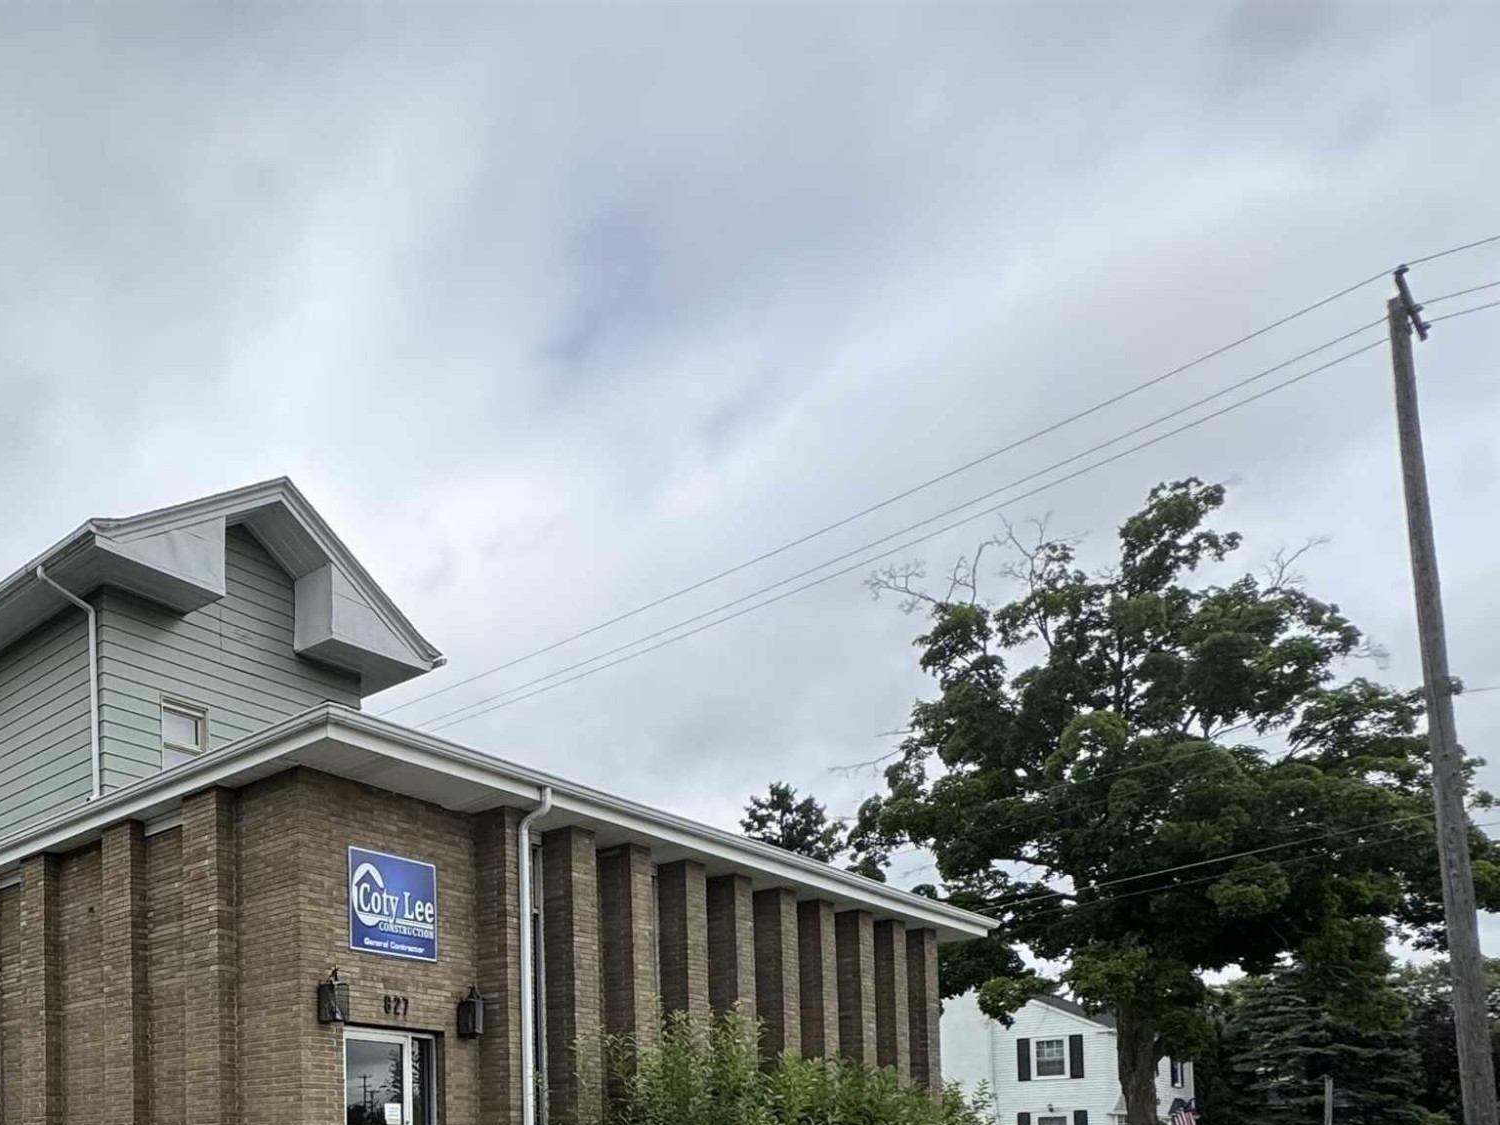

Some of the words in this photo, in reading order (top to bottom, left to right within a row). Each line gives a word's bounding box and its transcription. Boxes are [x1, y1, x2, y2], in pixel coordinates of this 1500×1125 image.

[359, 882, 399, 923] Coty
[403, 891, 435, 923] Lee
[379, 921, 434, 940] CONSTRUCTION
[363, 936, 389, 949] General
[390, 941, 425, 954] Contractor
[384, 995, 409, 1016] 827
